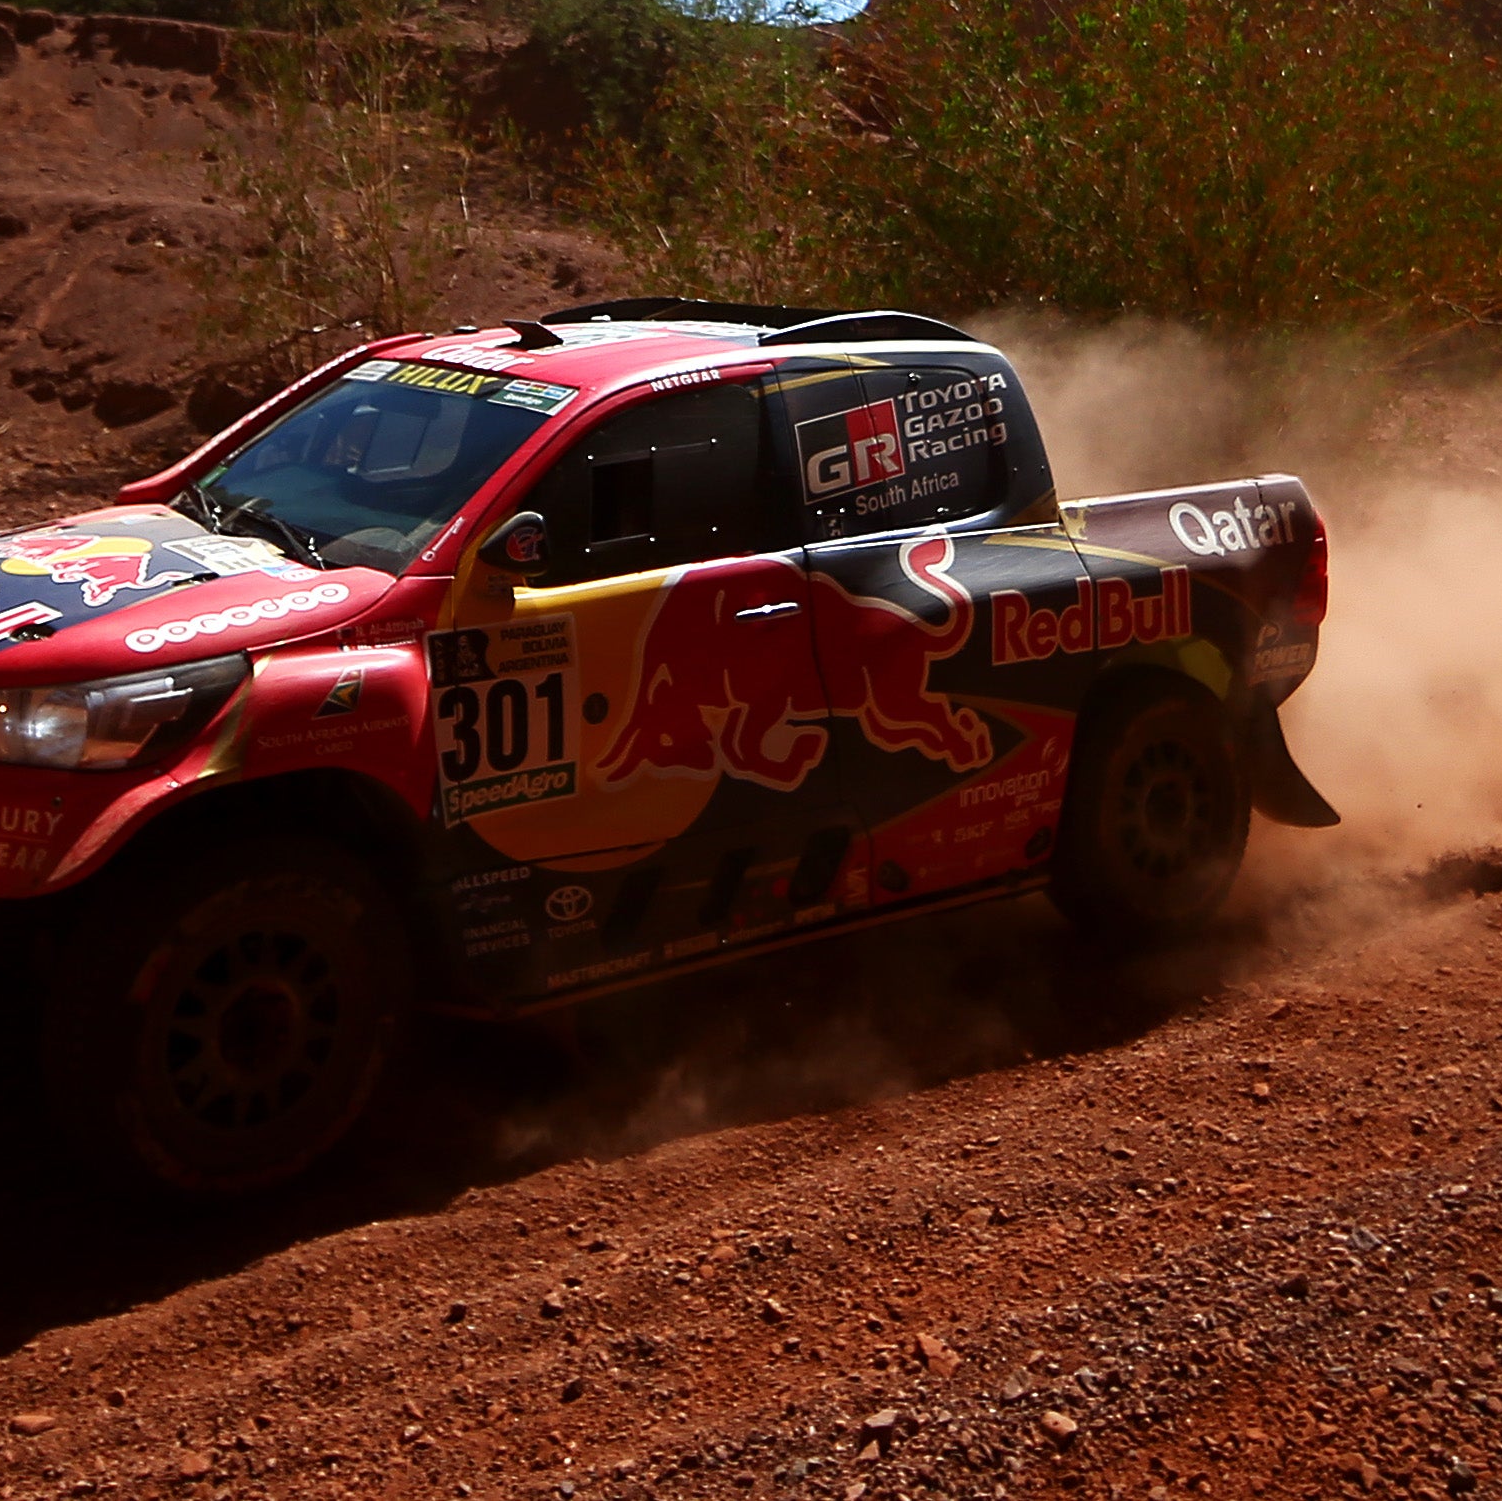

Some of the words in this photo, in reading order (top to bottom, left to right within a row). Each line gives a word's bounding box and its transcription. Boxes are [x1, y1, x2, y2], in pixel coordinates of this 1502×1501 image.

[387, 364, 500, 395] HILUX
[649, 369, 722, 392] NETGEAR
[898, 372, 1007, 414] TOYOTA
[903, 397, 1004, 438] GAZOO
[806, 432, 899, 495] GR
[907, 421, 1008, 463] Racing
[855, 486, 907, 516] South
[911, 470, 960, 500] Africa
[1168, 496, 1296, 557] Qatar
[437, 672, 564, 783] 301
[448, 770, 569, 814] SpeedAgro
